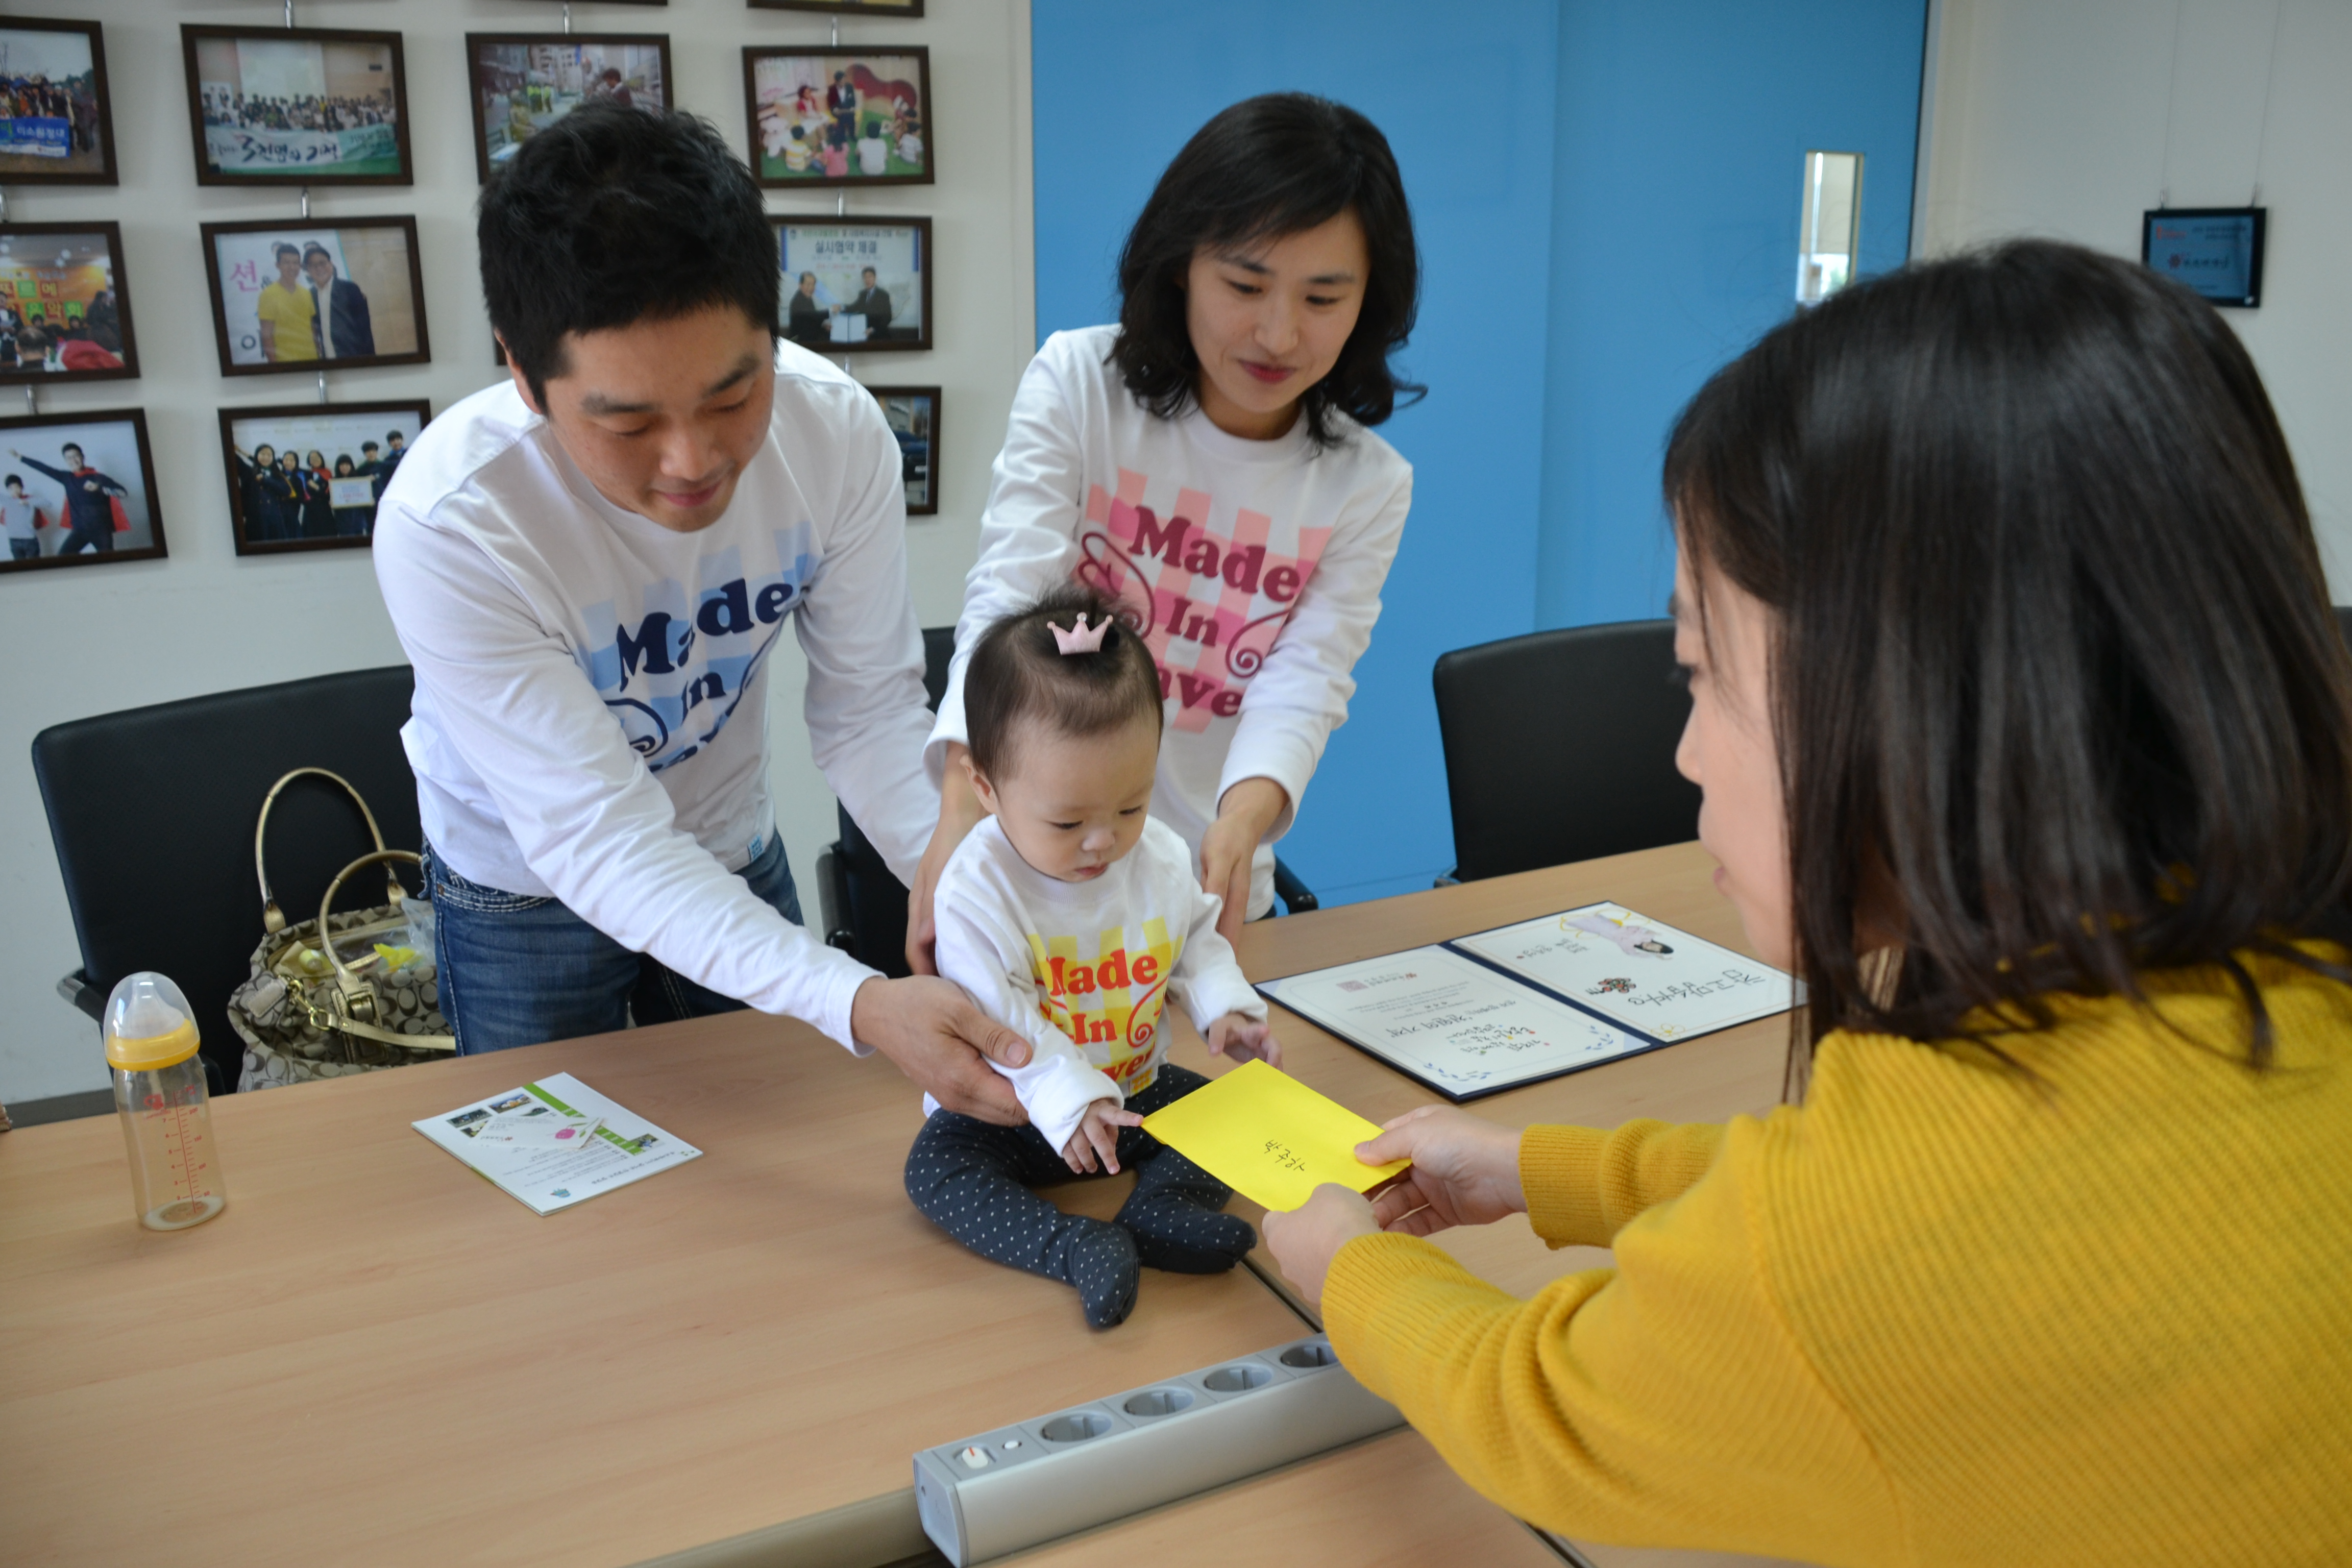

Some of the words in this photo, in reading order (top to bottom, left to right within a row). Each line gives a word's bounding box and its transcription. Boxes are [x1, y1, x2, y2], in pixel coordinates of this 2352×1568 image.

[1127, 505, 1300, 603] Made
[1165, 597, 1220, 647] In
[1071, 1013, 1117, 1044] In
